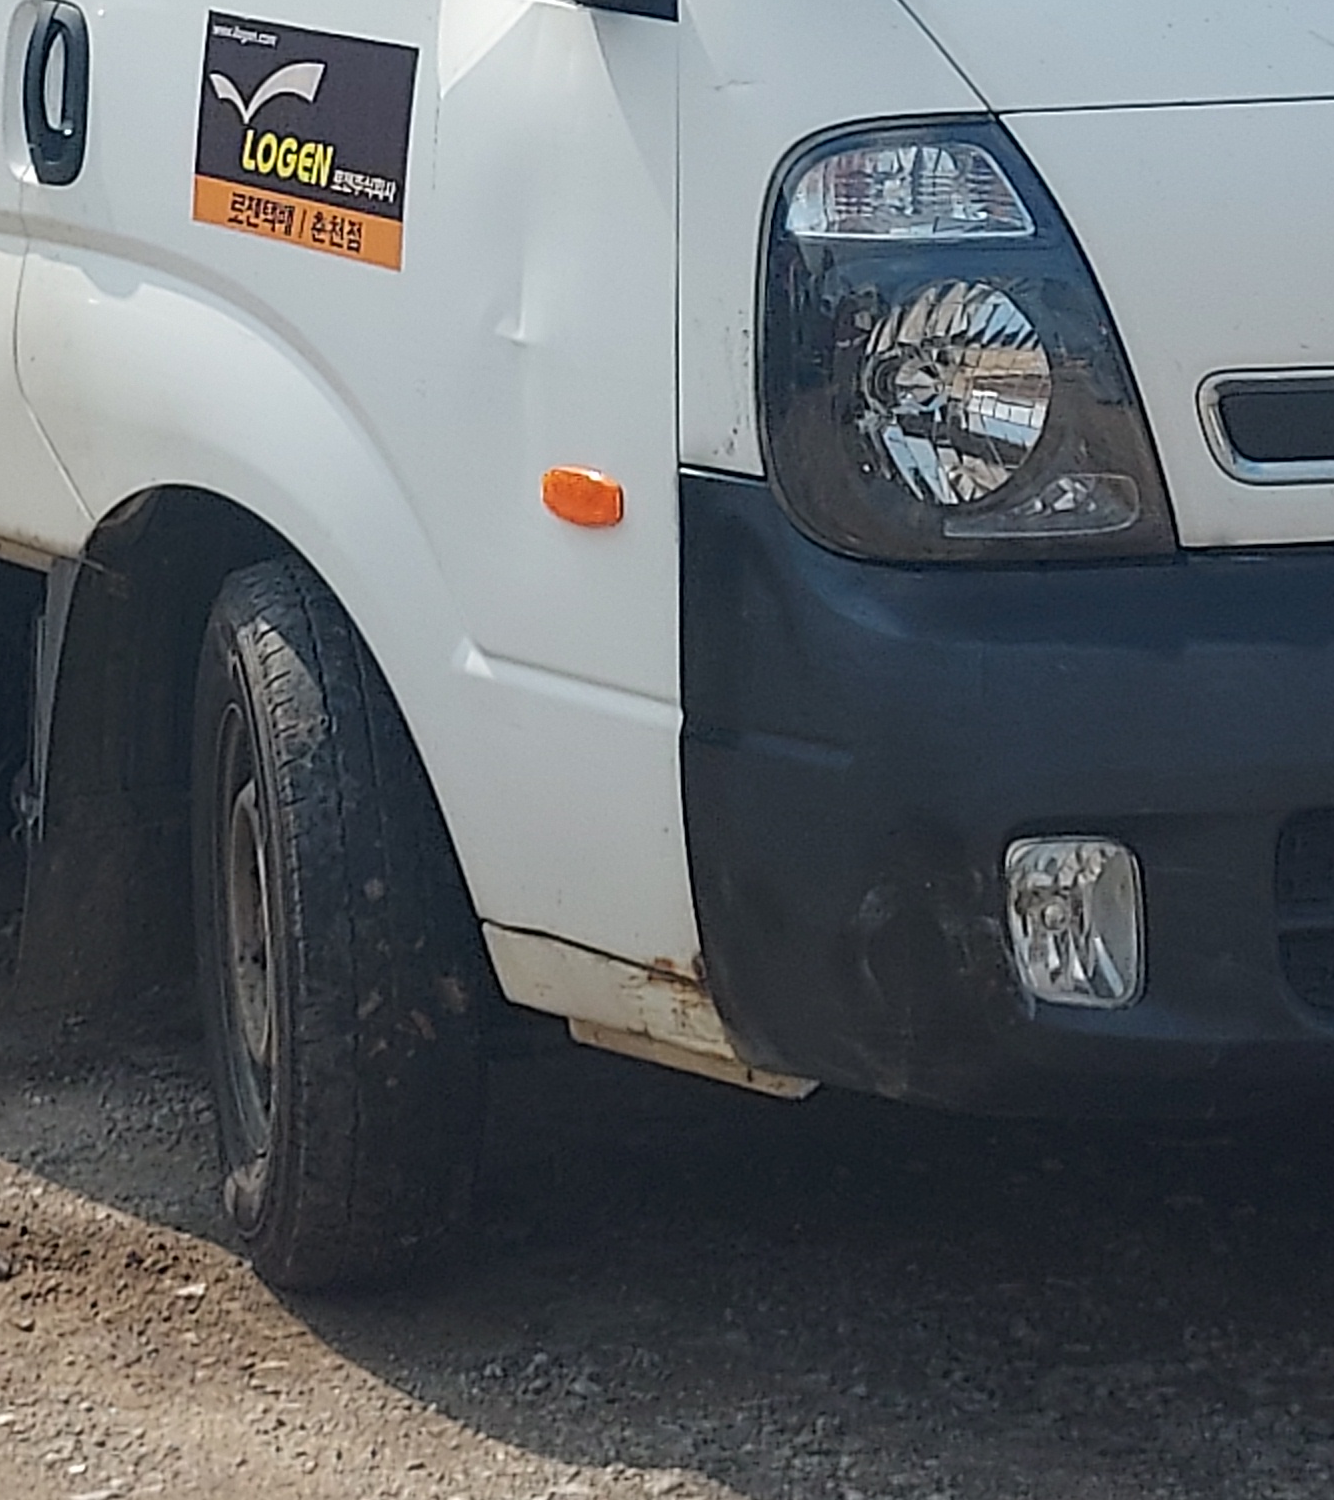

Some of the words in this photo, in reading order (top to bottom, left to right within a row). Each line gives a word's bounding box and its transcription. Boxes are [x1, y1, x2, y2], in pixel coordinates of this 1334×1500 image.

[241, 129, 334, 188] LOGEN
[227, 191, 295, 236] 로젠택배
[310, 211, 363, 254] 춘천점
